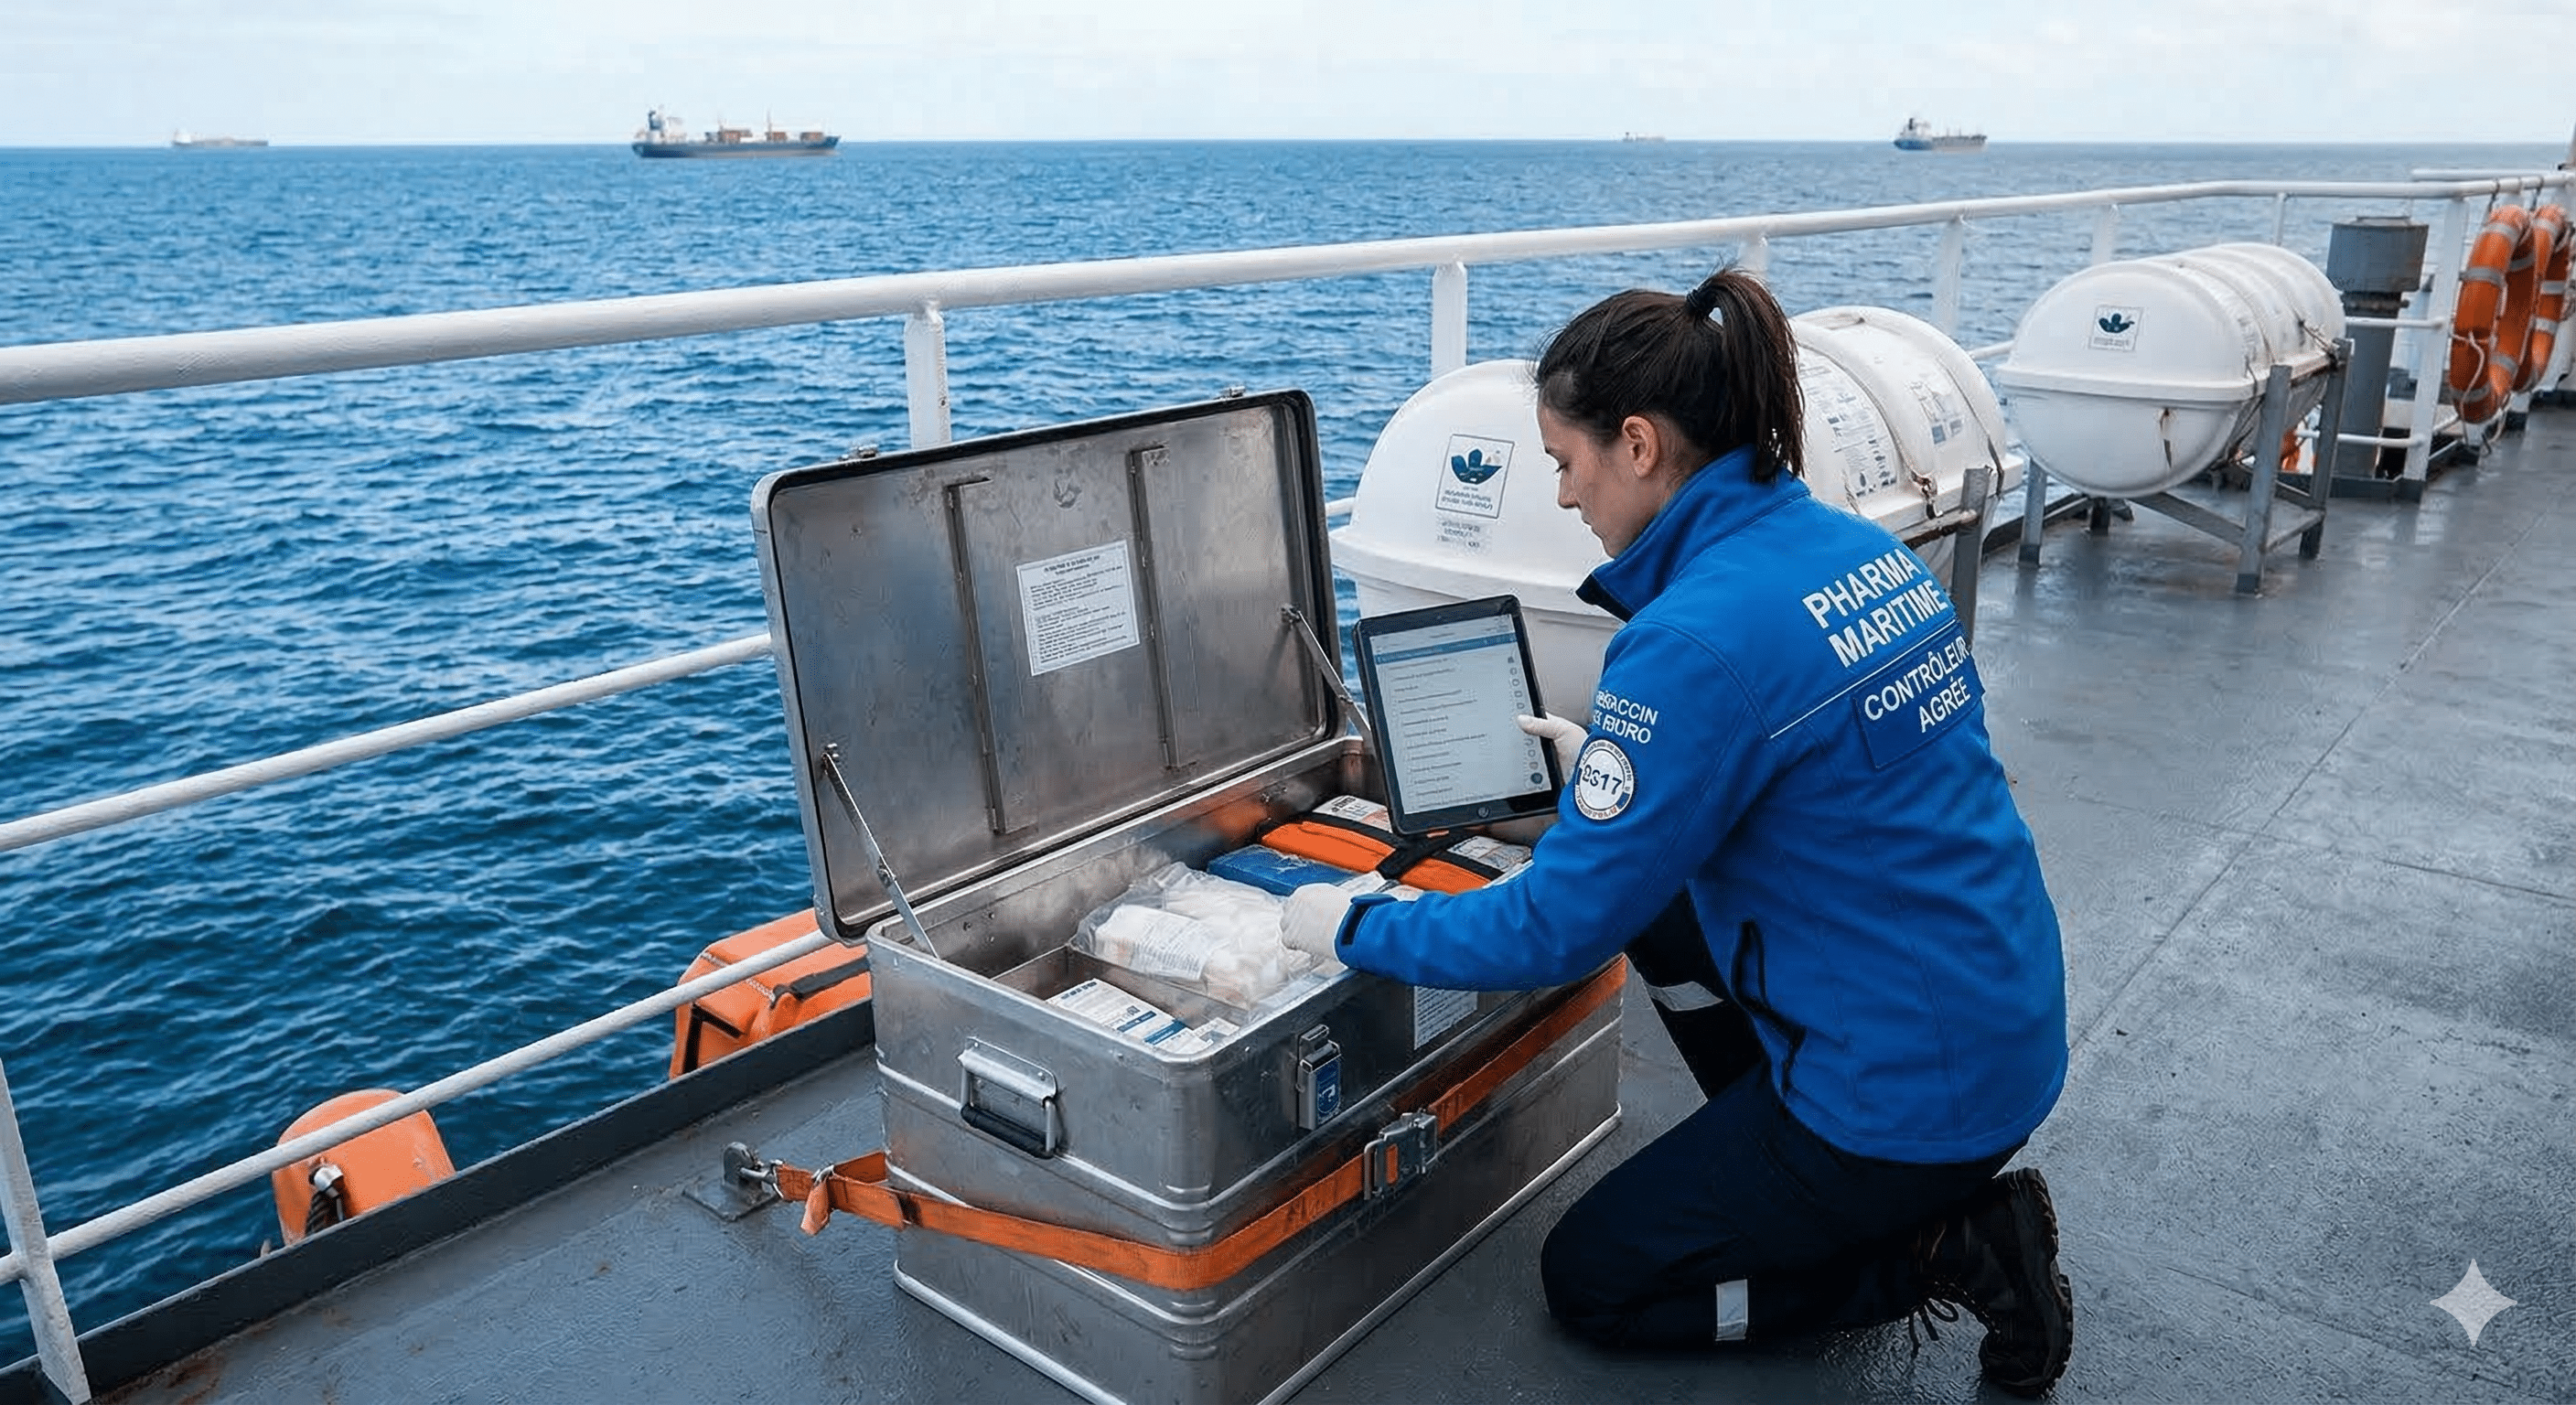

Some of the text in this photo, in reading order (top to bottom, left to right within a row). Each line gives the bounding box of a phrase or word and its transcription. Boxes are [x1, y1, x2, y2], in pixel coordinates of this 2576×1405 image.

[1802, 548, 1922, 629] PHARMA
[1828, 579, 1948, 668] MARITIME
[1864, 636, 1970, 721] CONTRÔLEUR
[1918, 676, 1971, 733] AGRÉE
